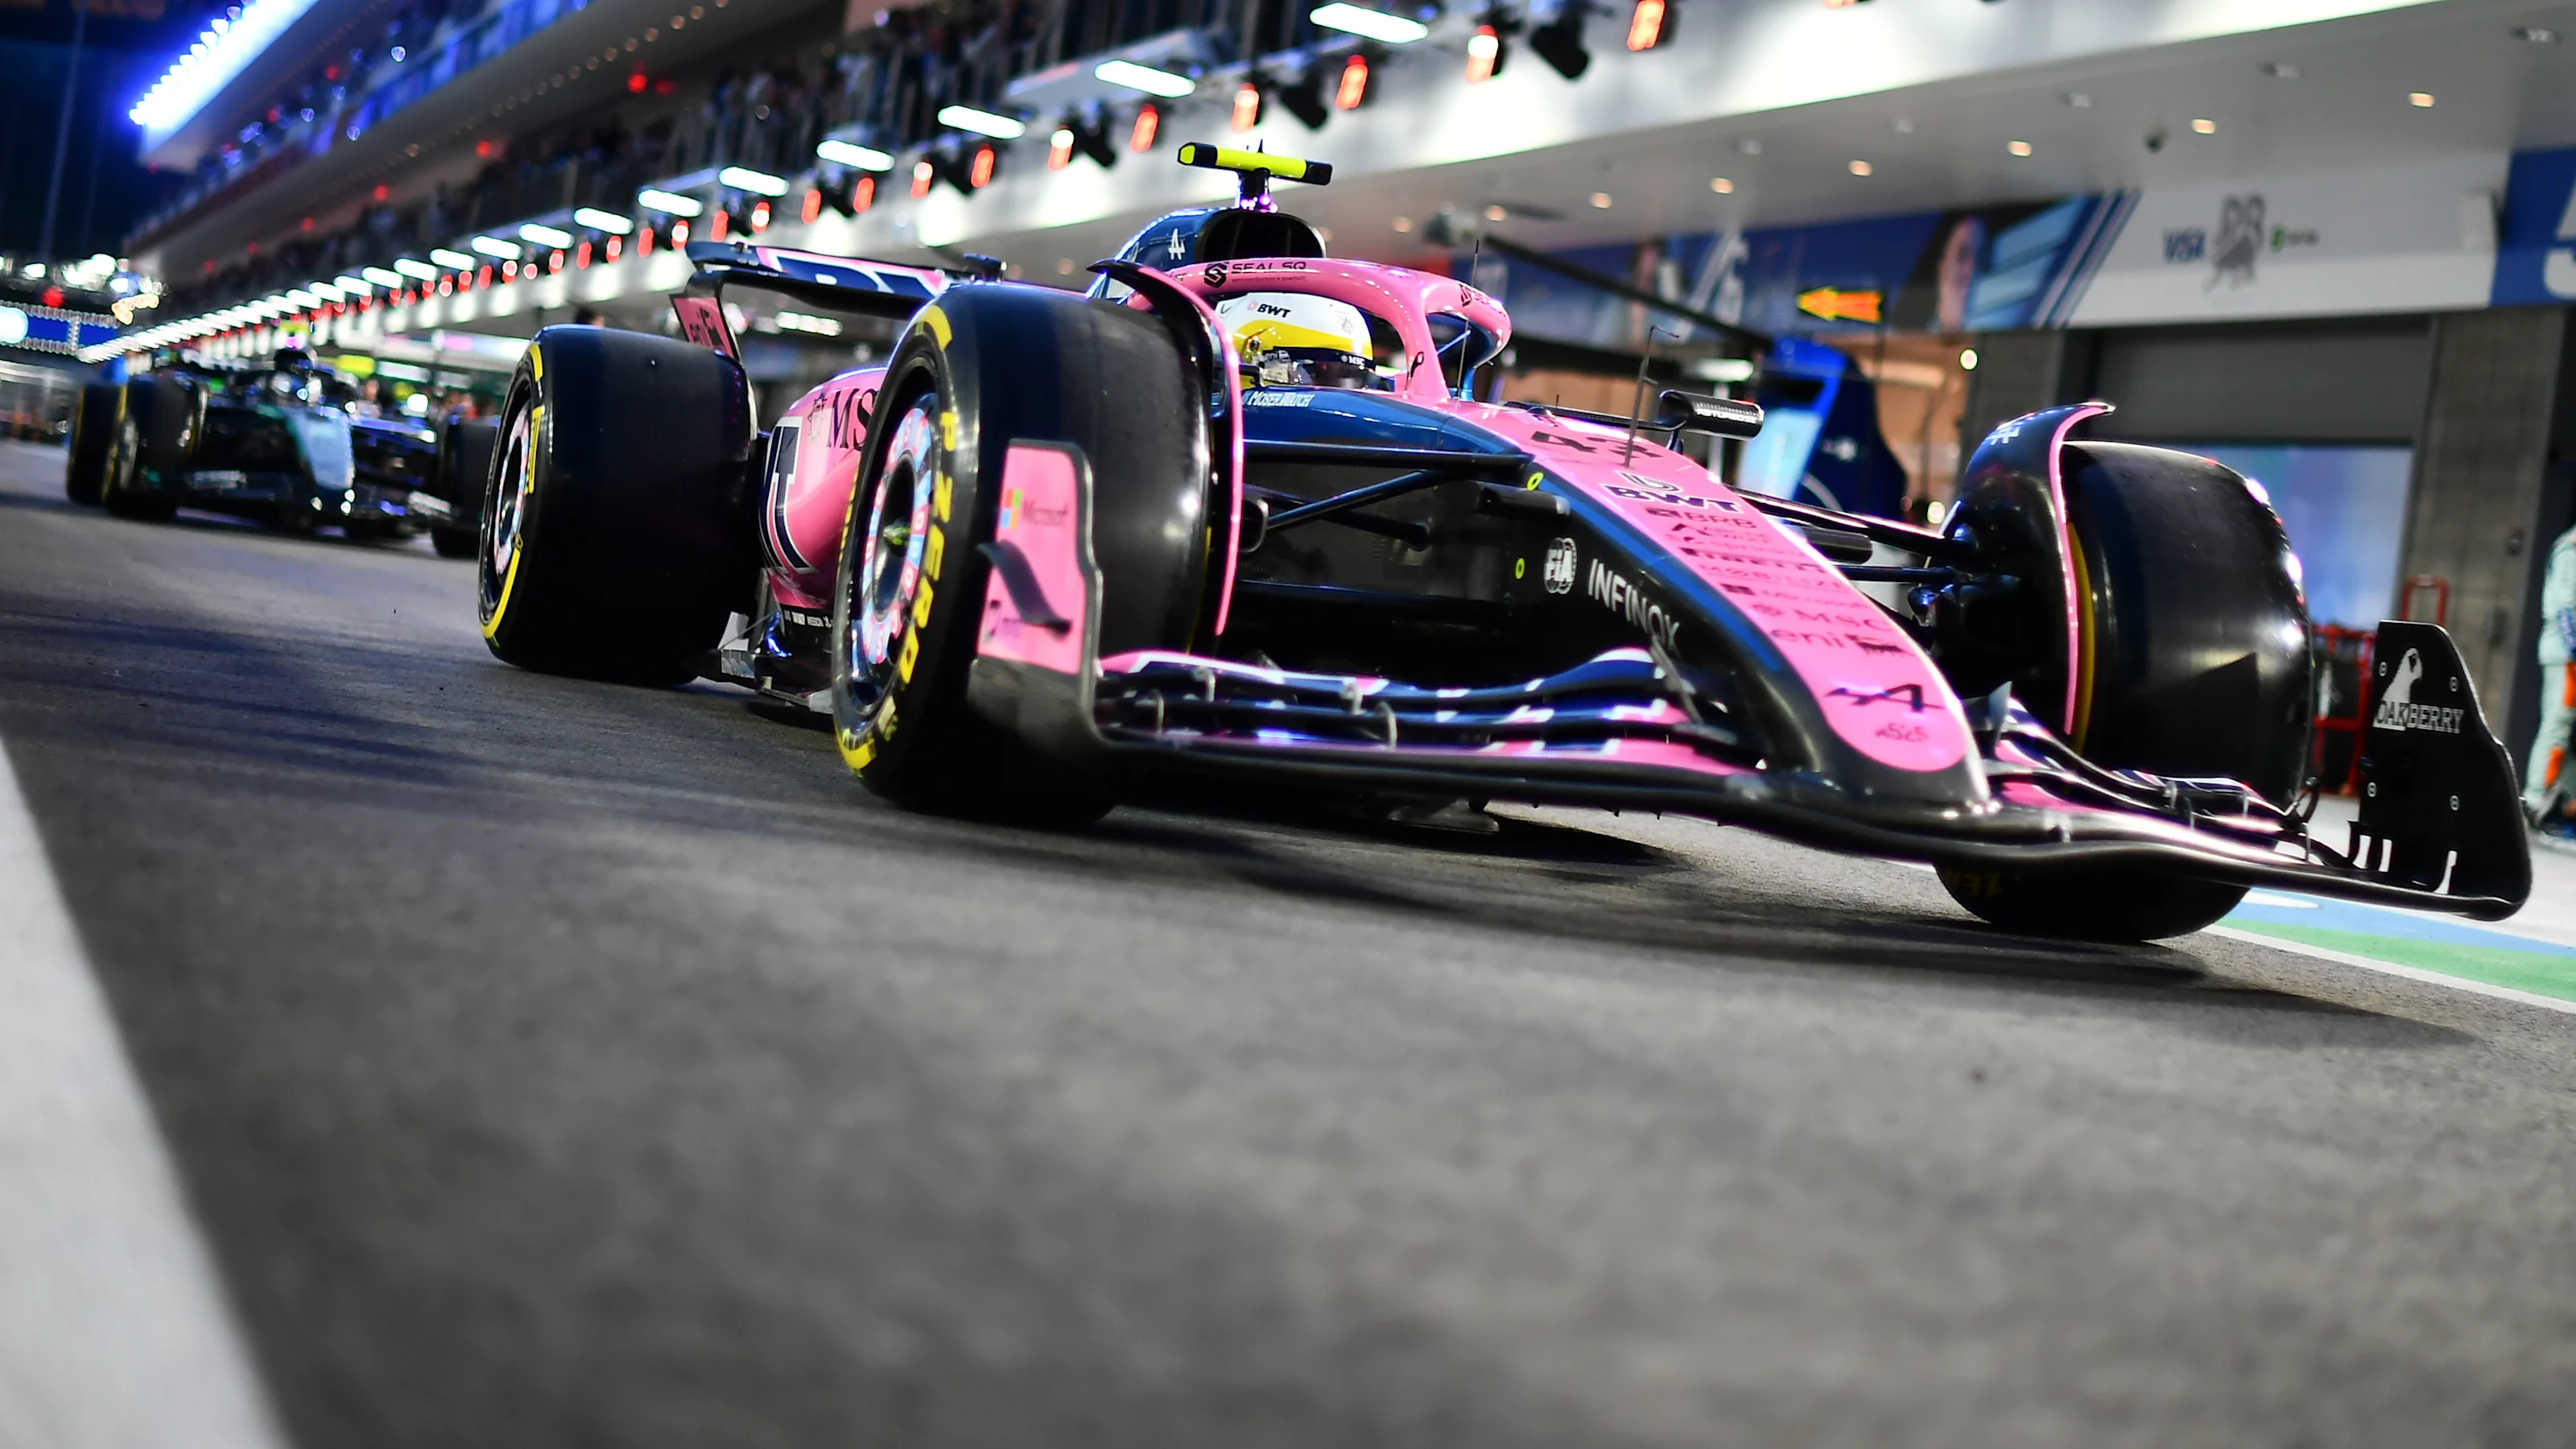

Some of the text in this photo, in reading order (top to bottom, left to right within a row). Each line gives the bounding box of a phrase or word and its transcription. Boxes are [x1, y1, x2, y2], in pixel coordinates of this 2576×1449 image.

[1257, 303, 1291, 318] BWT
[1348, 355, 1365, 366] MSC
[1531, 431, 1664, 459] 43
[1603, 485, 1741, 513] BWT
[1588, 558, 1681, 654] INFINOX
[1794, 609, 1893, 631] MSC
[1771, 629, 1845, 648] eni
[2377, 700, 2465, 734] OAKBERRY
